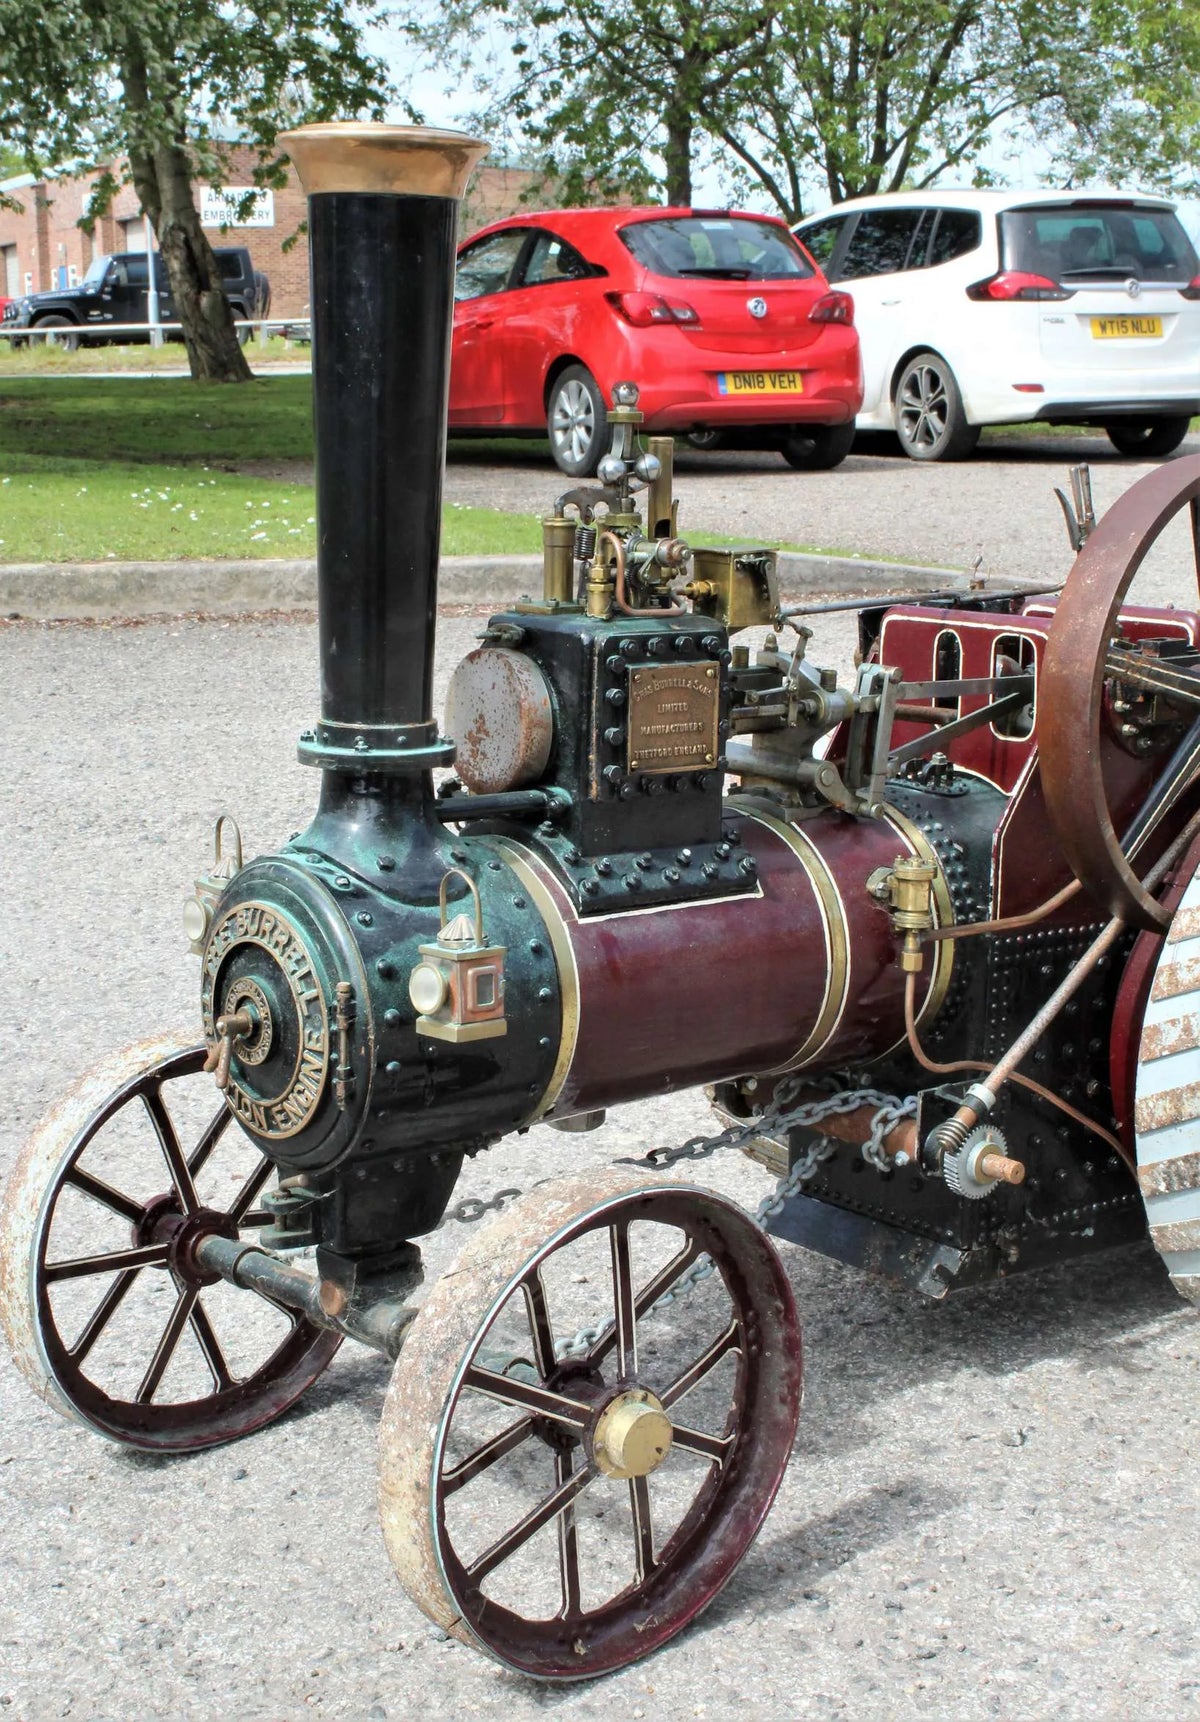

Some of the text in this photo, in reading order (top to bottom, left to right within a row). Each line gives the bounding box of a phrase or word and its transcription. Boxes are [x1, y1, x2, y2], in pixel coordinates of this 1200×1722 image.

[1099, 318, 1156, 335] WT15 NLU
[732, 373, 798, 390] DN18 VEH
[657, 702, 688, 714] LIMITED
[640, 722, 704, 735] MANUFACTURERS
[634, 743, 708, 760] THETFORD ENGLAND
[235, 907, 320, 1018] BURRELL
[271, 1028, 325, 1131] ENGINE
